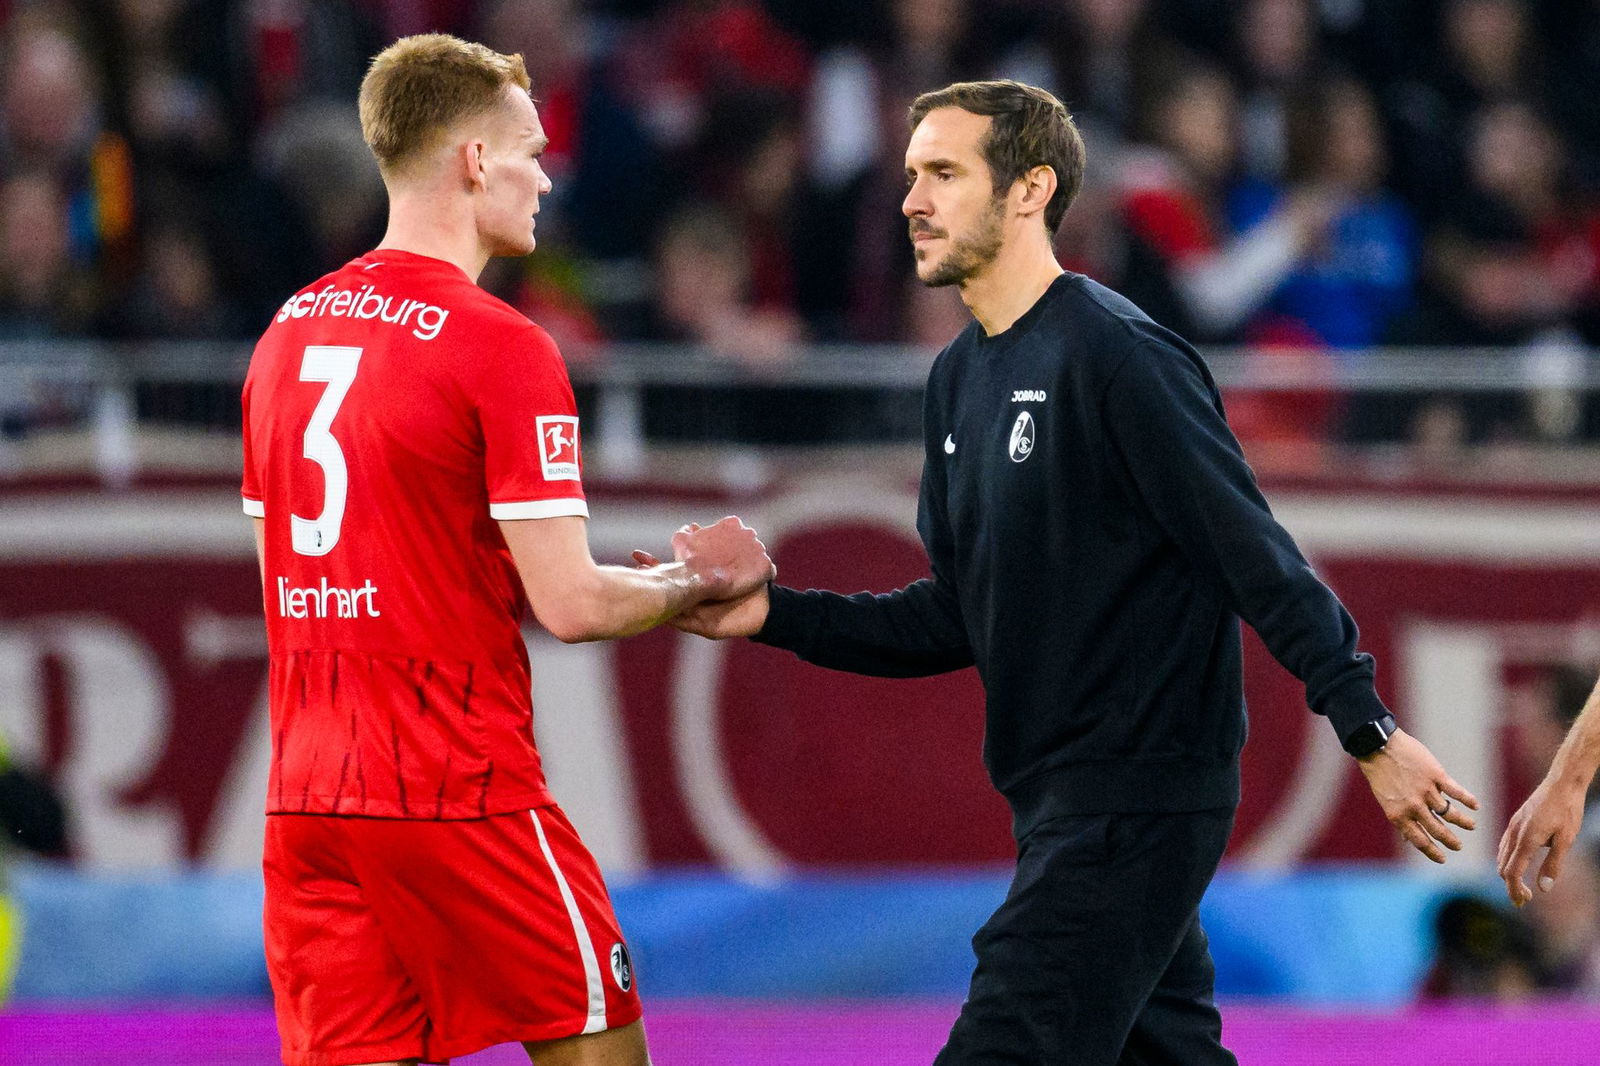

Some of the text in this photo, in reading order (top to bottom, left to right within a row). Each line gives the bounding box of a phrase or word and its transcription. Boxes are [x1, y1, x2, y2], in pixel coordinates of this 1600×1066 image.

[1011, 389, 1047, 402] JOBRAD
[291, 345, 364, 557] 3
[277, 576, 381, 619] lienhart
